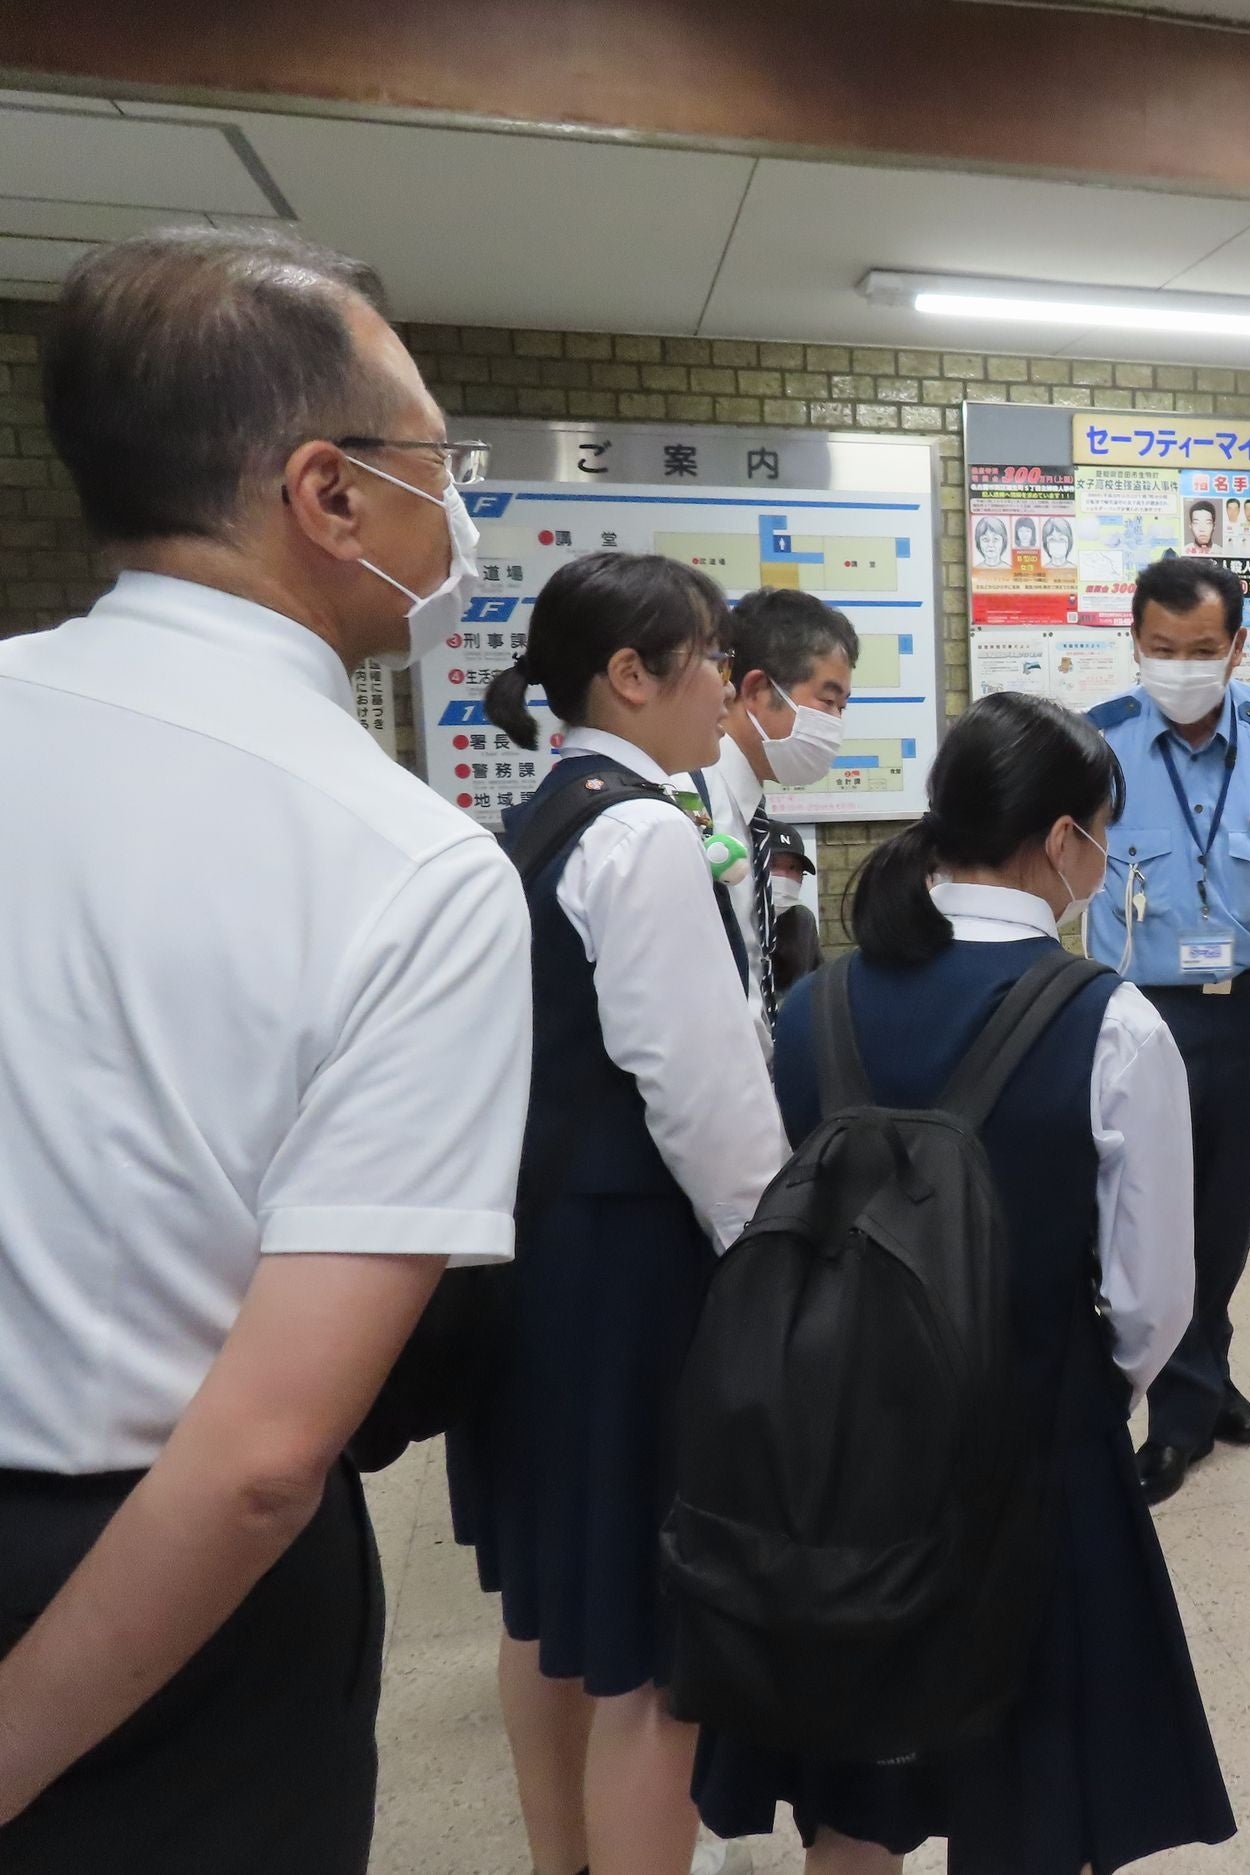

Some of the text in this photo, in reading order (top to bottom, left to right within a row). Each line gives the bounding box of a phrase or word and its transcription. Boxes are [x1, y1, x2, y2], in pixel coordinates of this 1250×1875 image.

[577, 440, 779, 480] ご案内
[555, 530, 618, 547] 講堂
[464, 633, 528, 649] 刑事課
[472, 762, 536, 779] 警務課
[836, 778, 861, 786] 会計課
[780, 835, 790, 845] N
